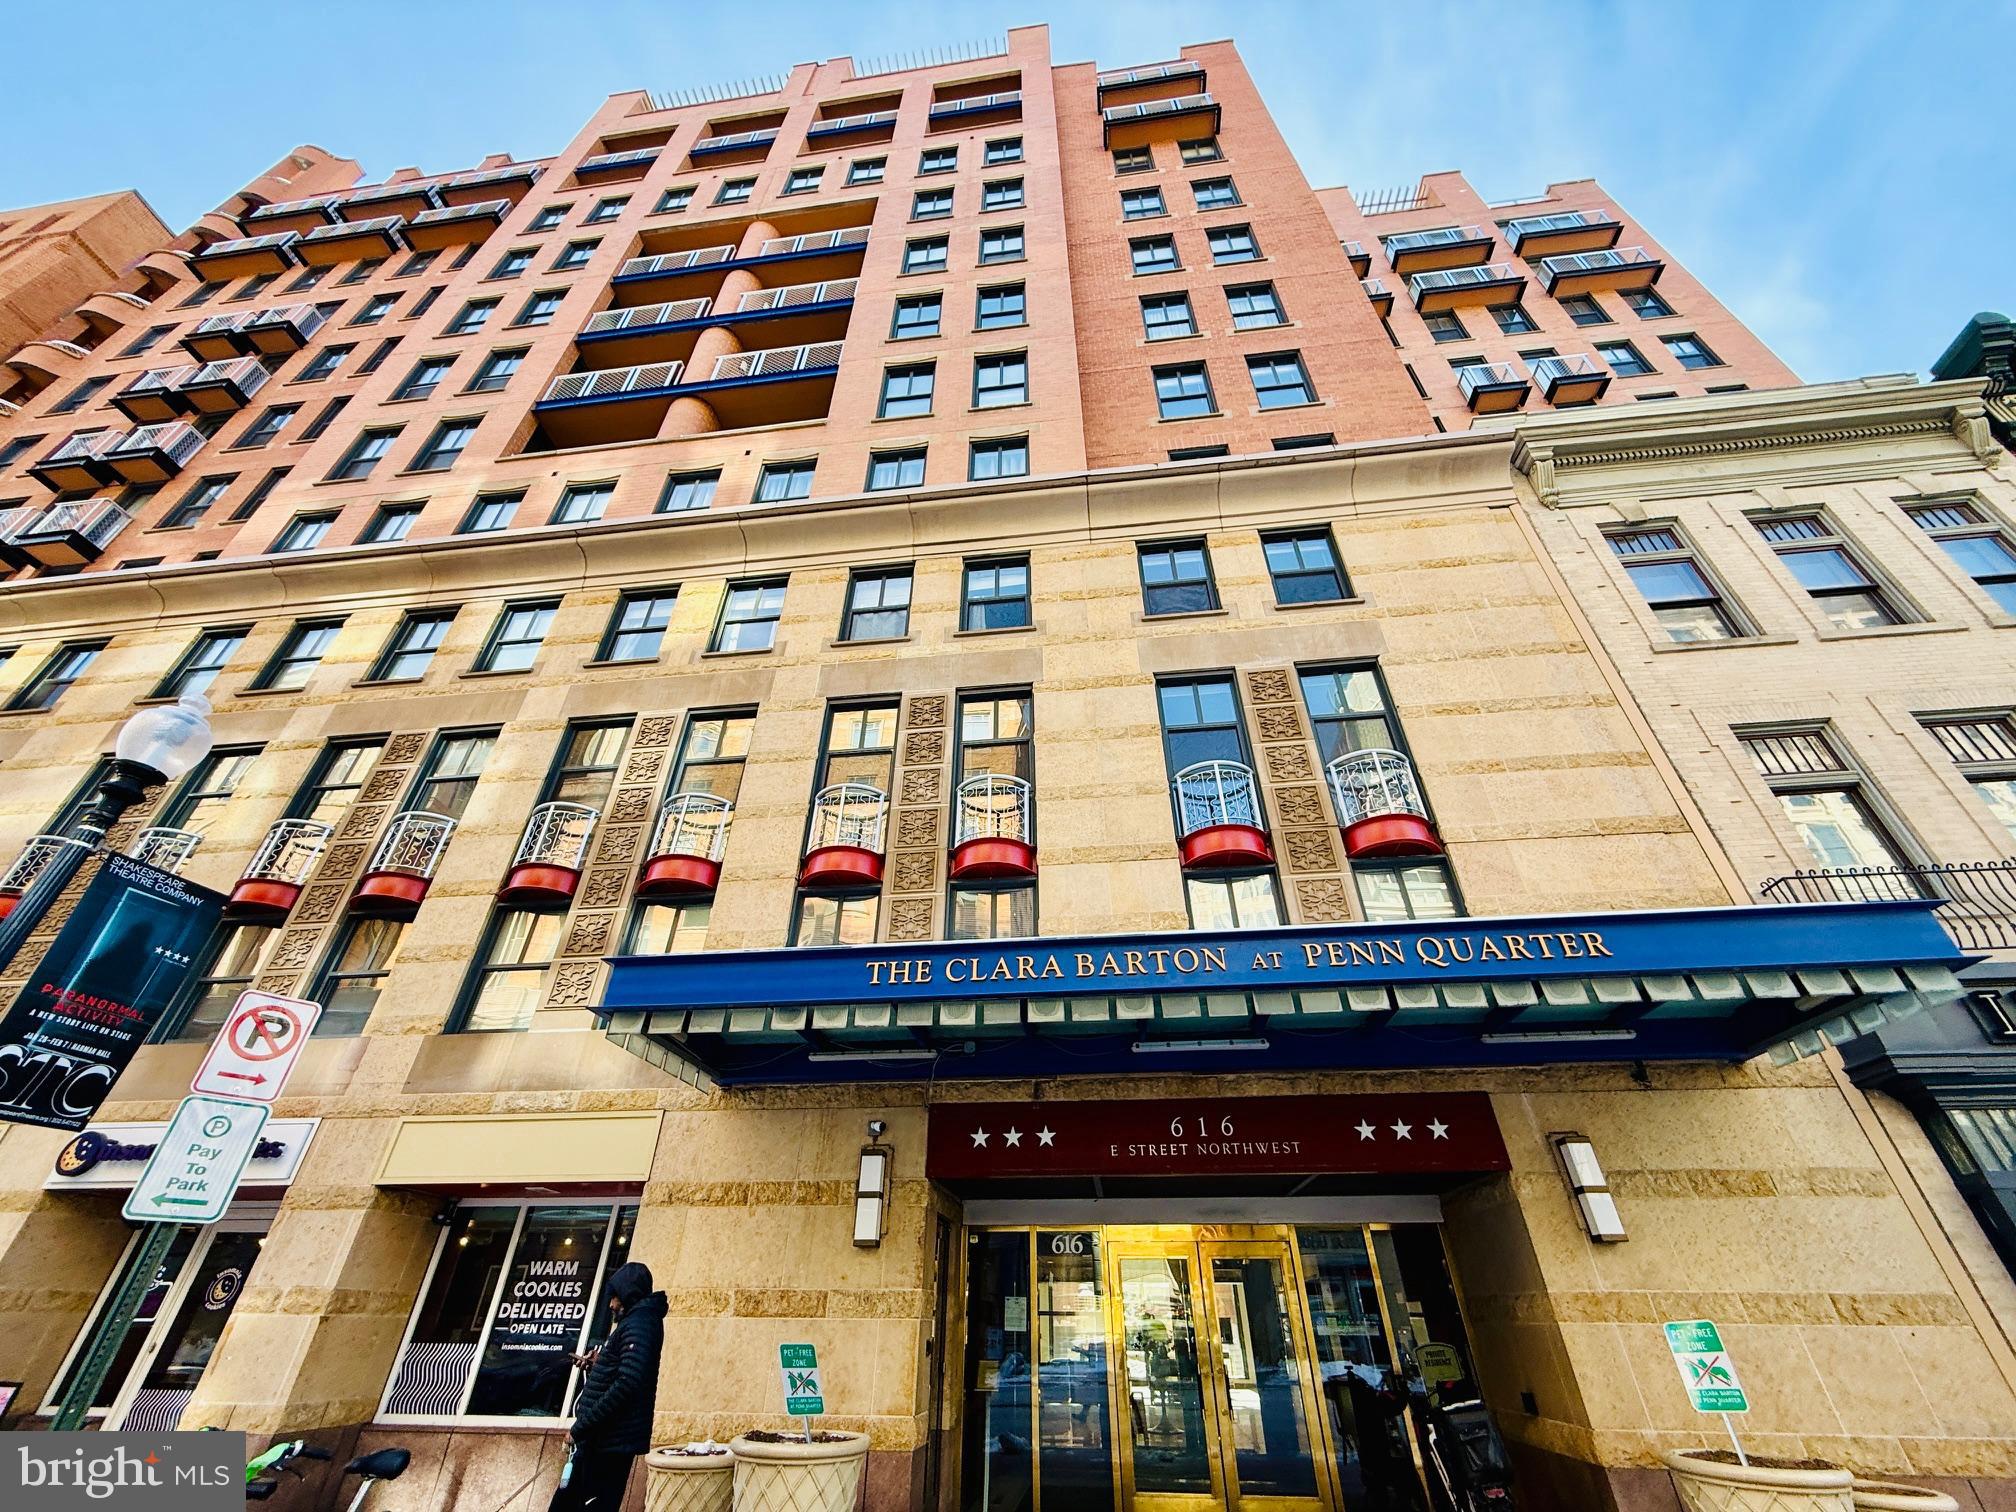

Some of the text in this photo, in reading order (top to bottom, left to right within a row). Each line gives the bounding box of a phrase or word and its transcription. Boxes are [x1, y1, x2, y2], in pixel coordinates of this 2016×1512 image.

[112, 856, 186, 890] SHAKESPEARE
[108, 864, 205, 906] THEATRE COMPANY
[866, 932, 1614, 985] THE CLARA BARTON AT PENN QUARTER
[41, 983, 145, 1021] PARANORMAL
[52, 1002, 125, 1026] ACTIVITY
[29, 1008, 132, 1041] A NEW STORY LIVE ON STAGE
[187, 1143, 222, 1161] Pay
[1110, 1141, 1301, 1157] E STREET NORTHWEST
[186, 1162, 207, 1176] To
[166, 1177, 208, 1192] Park
[1051, 1234, 1084, 1254] 616
[530, 1261, 580, 1276] WARM
[513, 1281, 583, 1297] COOKIES
[498, 1302, 586, 1319] DELIVERED
[509, 1323, 565, 1334] OPEN LATE
[1692, 1328, 1713, 1338] FREE
[501, 1342, 563, 1351] insomniacookies.com
[1687, 1341, 1708, 1351] ZONE
[792, 1359, 807, 1367] ZONE
